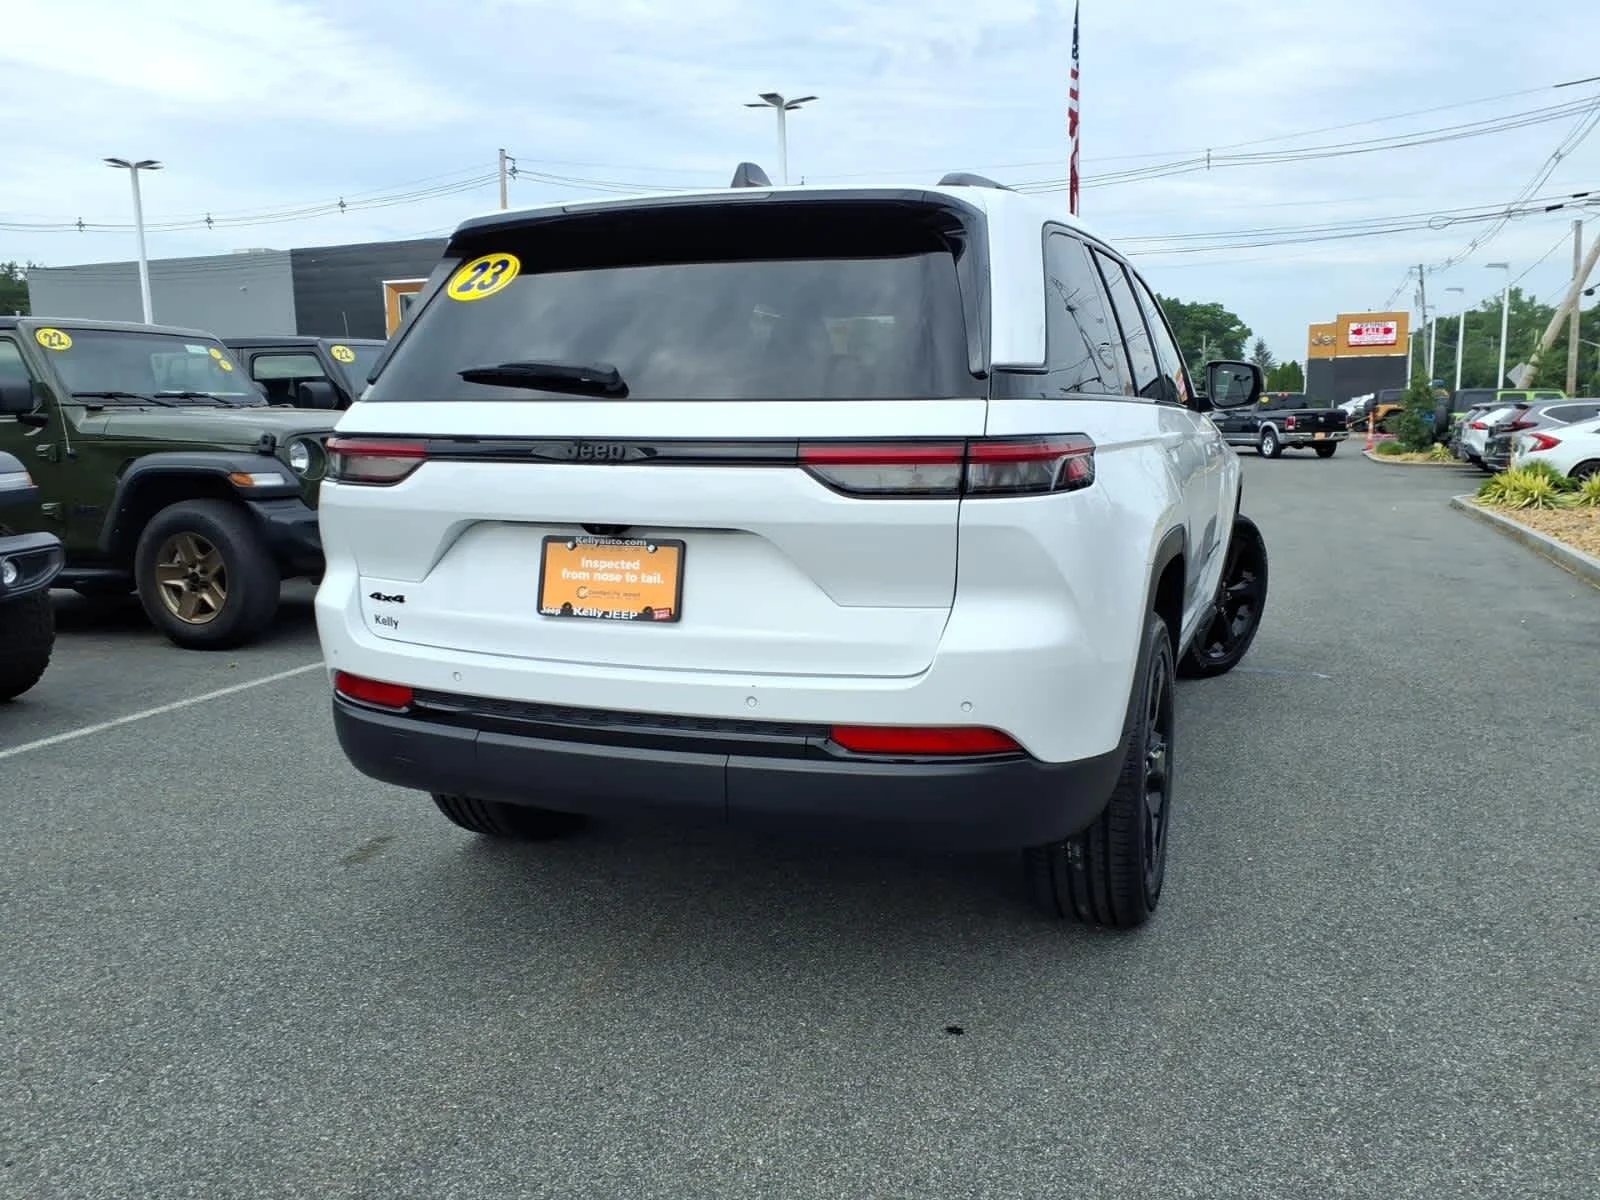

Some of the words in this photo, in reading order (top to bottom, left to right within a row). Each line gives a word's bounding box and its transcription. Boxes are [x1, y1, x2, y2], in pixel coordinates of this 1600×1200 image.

[457, 259, 510, 293] 23
[44, 331, 66, 347] 22
[565, 440, 624, 461] Jeep
[575, 536, 647, 548] Kellyauto.com
[581, 557, 641, 570] Inspected
[562, 568, 591, 580] from
[593, 572, 623, 582] nose
[625, 572, 638, 583] to
[640, 573, 665, 585] tail.
[369, 592, 405, 603] 4x4
[572, 607, 604, 618] Kelly
[605, 609, 639, 620] JEEP
[374, 614, 399, 630] Kelly
